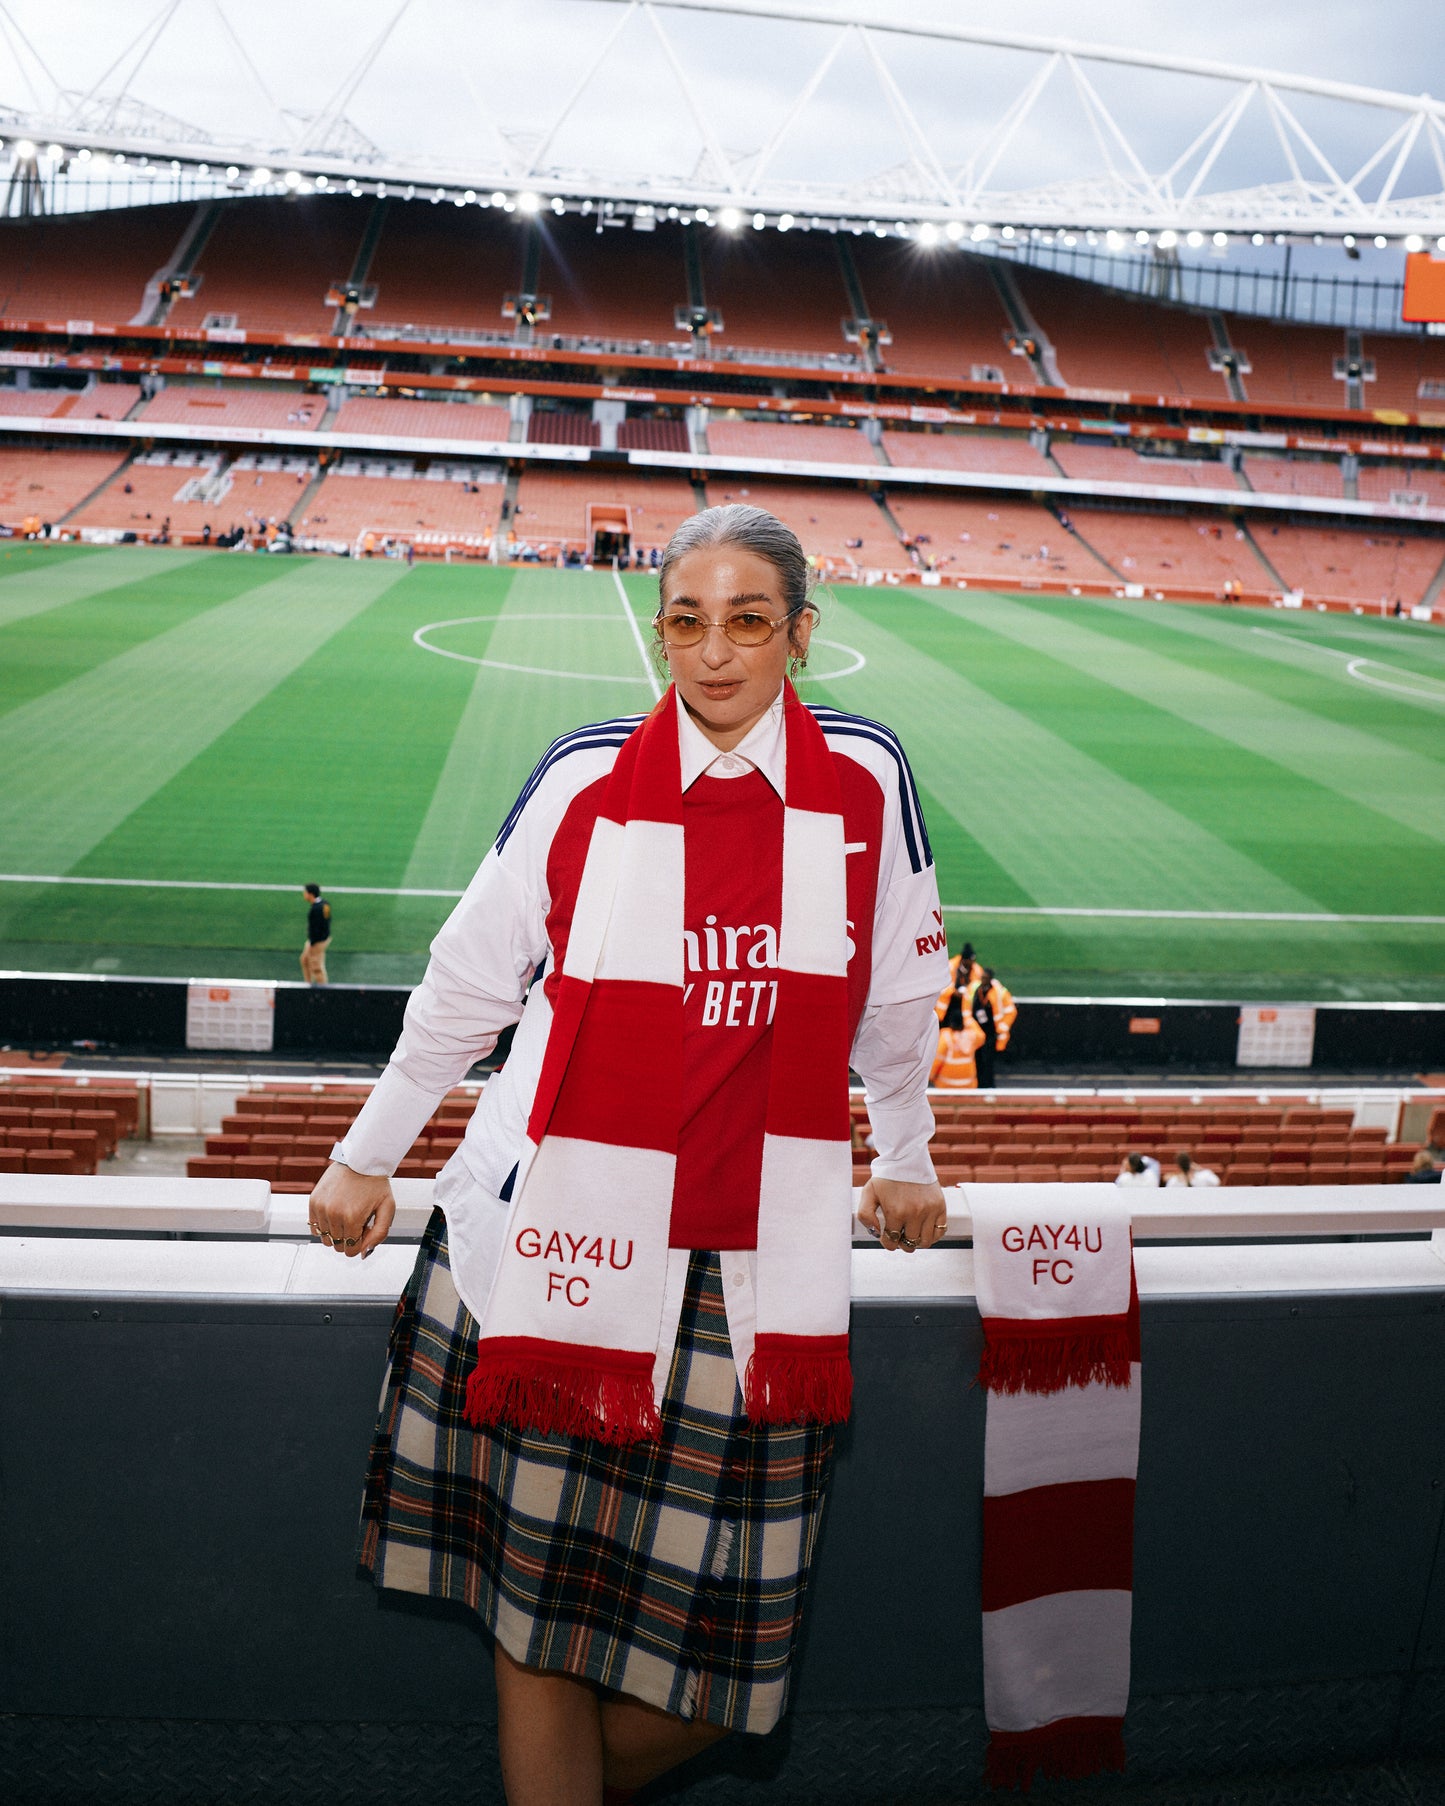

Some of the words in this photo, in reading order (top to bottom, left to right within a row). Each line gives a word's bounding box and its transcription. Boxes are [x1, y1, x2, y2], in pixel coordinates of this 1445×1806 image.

[701, 981, 778, 1027] BETT
[515, 1227, 634, 1270] GAY4U
[1002, 1224, 1103, 1253] GAY4U
[547, 1271, 590, 1307] FC
[1033, 1259, 1074, 1285] FC
